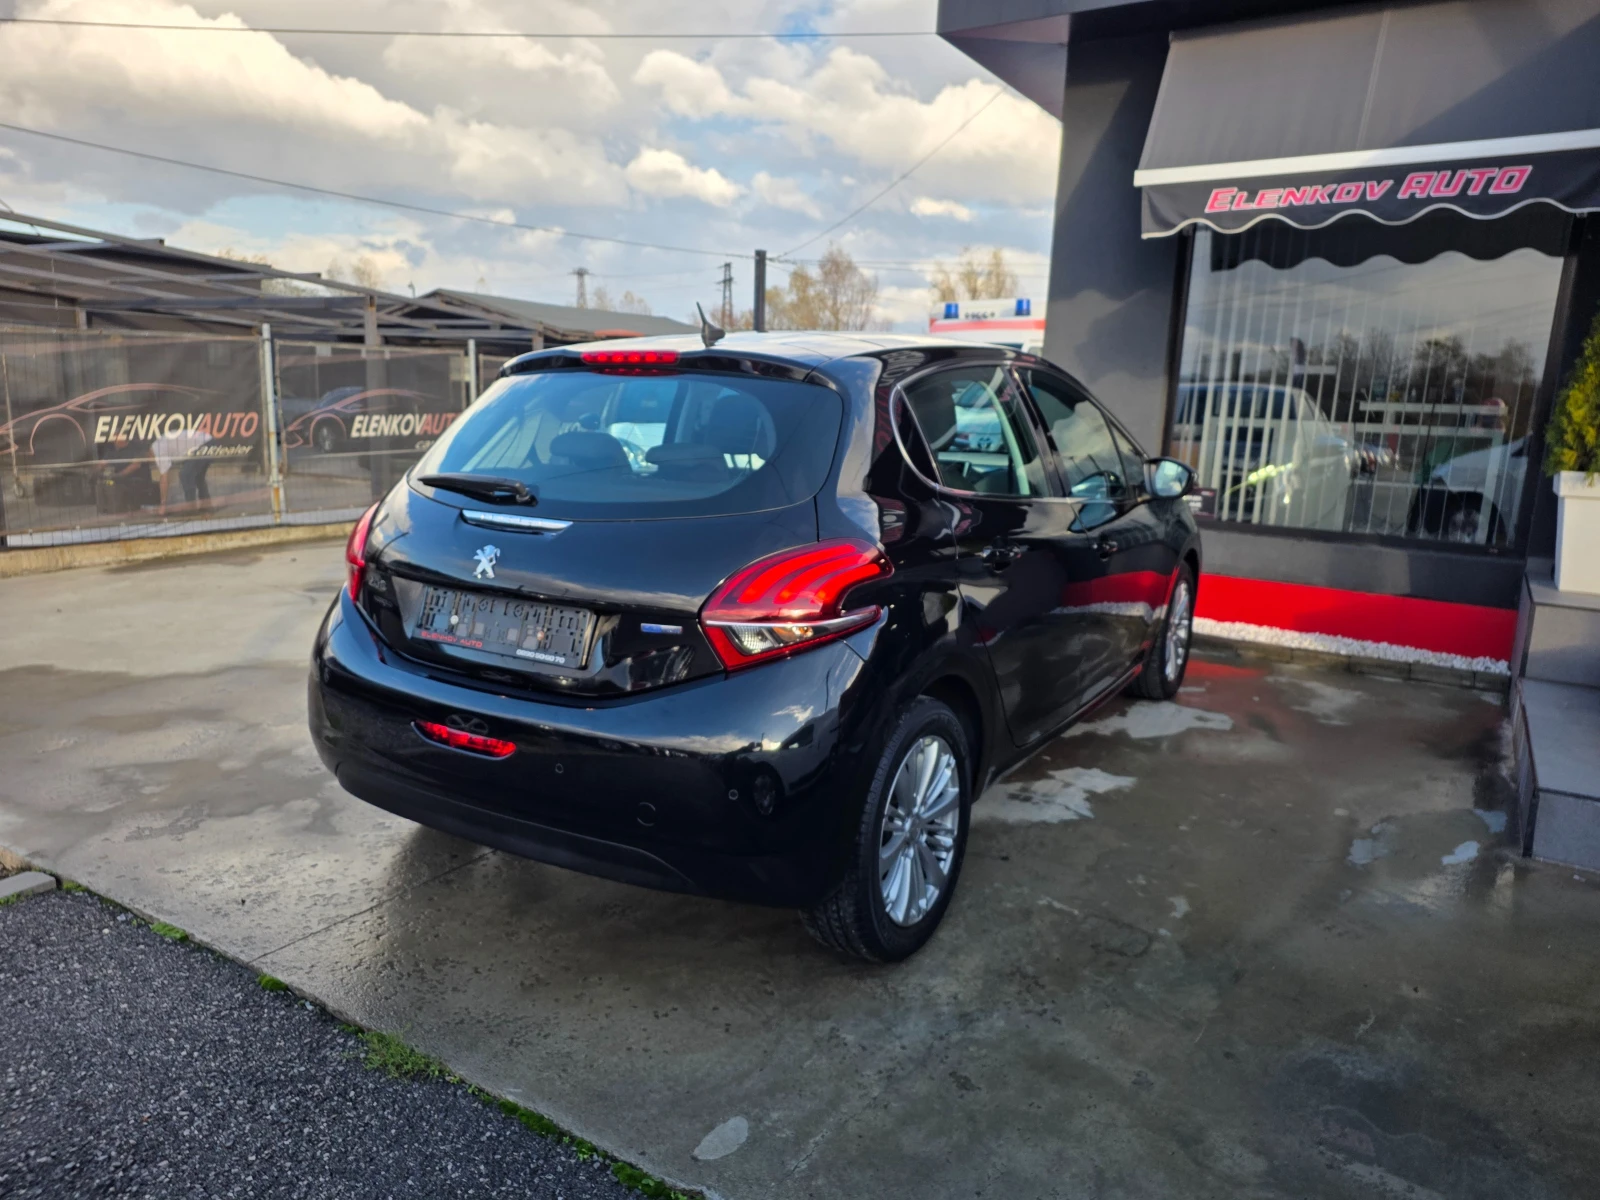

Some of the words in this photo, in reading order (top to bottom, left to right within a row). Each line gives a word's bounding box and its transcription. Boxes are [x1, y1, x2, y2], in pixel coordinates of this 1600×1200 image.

[1205, 180, 1394, 213] ELENKOV
[1397, 165, 1533, 199] AUTO
[94, 412, 259, 444] ELENKOVAUTO
[350, 412, 462, 438] ELENKOVAUT
[460, 638, 483, 648] AUTO
